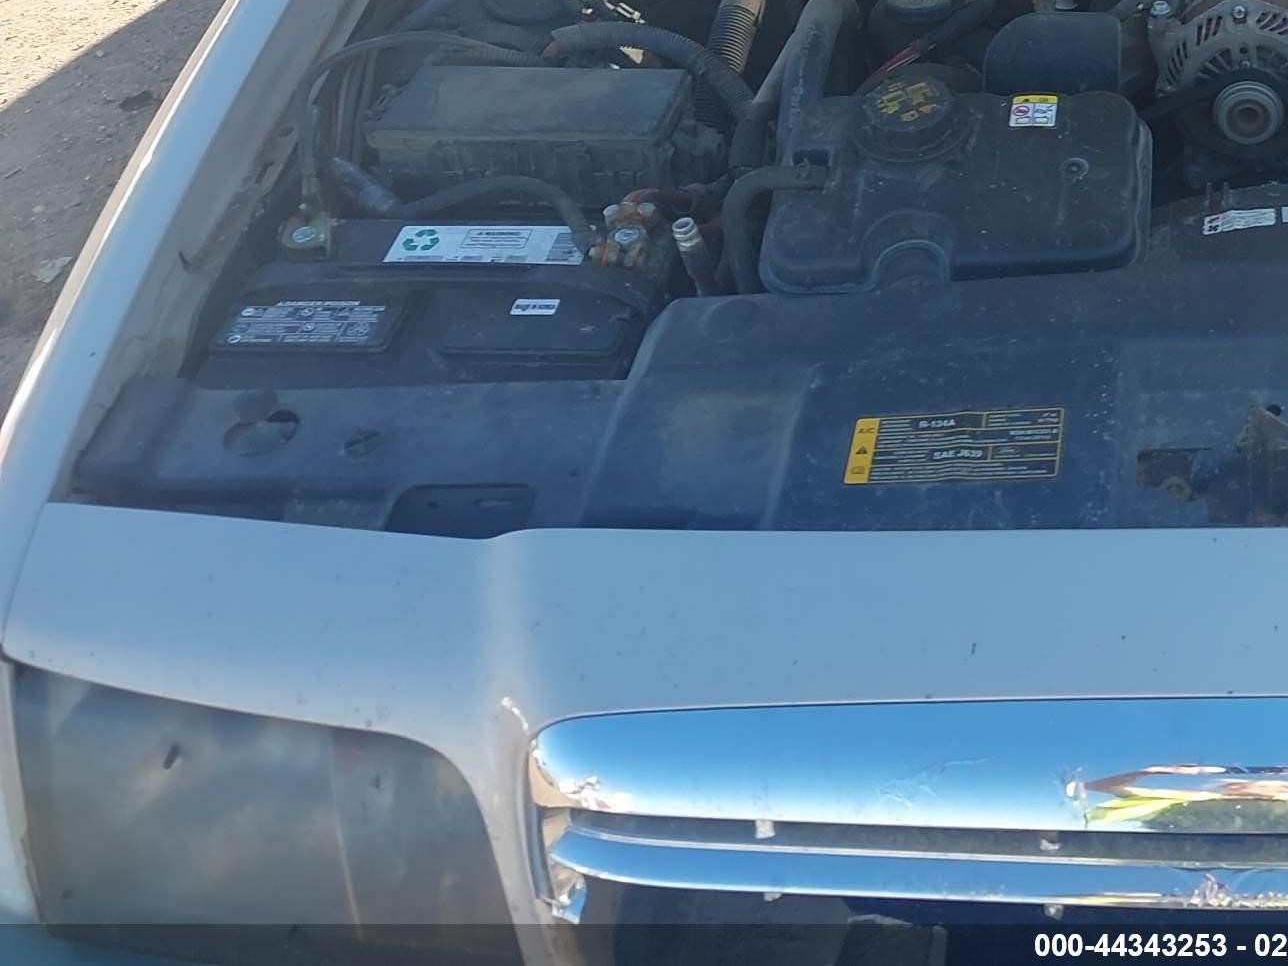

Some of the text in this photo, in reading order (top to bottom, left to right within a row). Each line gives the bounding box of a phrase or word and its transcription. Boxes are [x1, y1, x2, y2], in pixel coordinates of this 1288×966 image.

[918, 418, 956, 429] R-134A
[933, 450, 956, 460] SAE
[957, 449, 983, 459] J639
